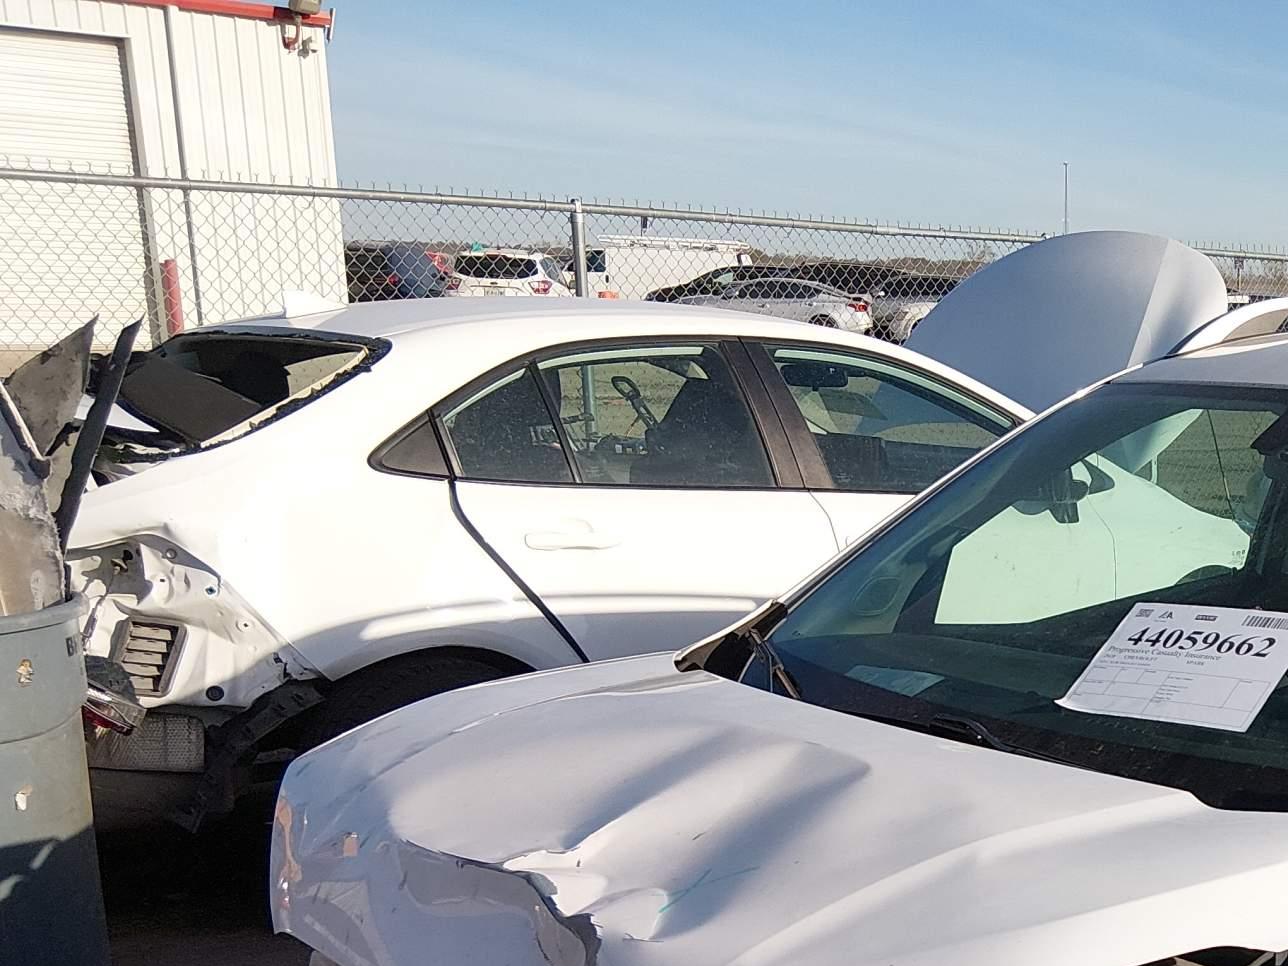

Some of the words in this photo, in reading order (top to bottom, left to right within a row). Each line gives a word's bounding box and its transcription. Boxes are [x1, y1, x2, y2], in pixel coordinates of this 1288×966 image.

[1109, 646, 1150, 654] Progressive
[1151, 649, 1182, 657] Casualty
[1184, 651, 1222, 660] Insurance
[1128, 627, 1276, 658] 44059662
